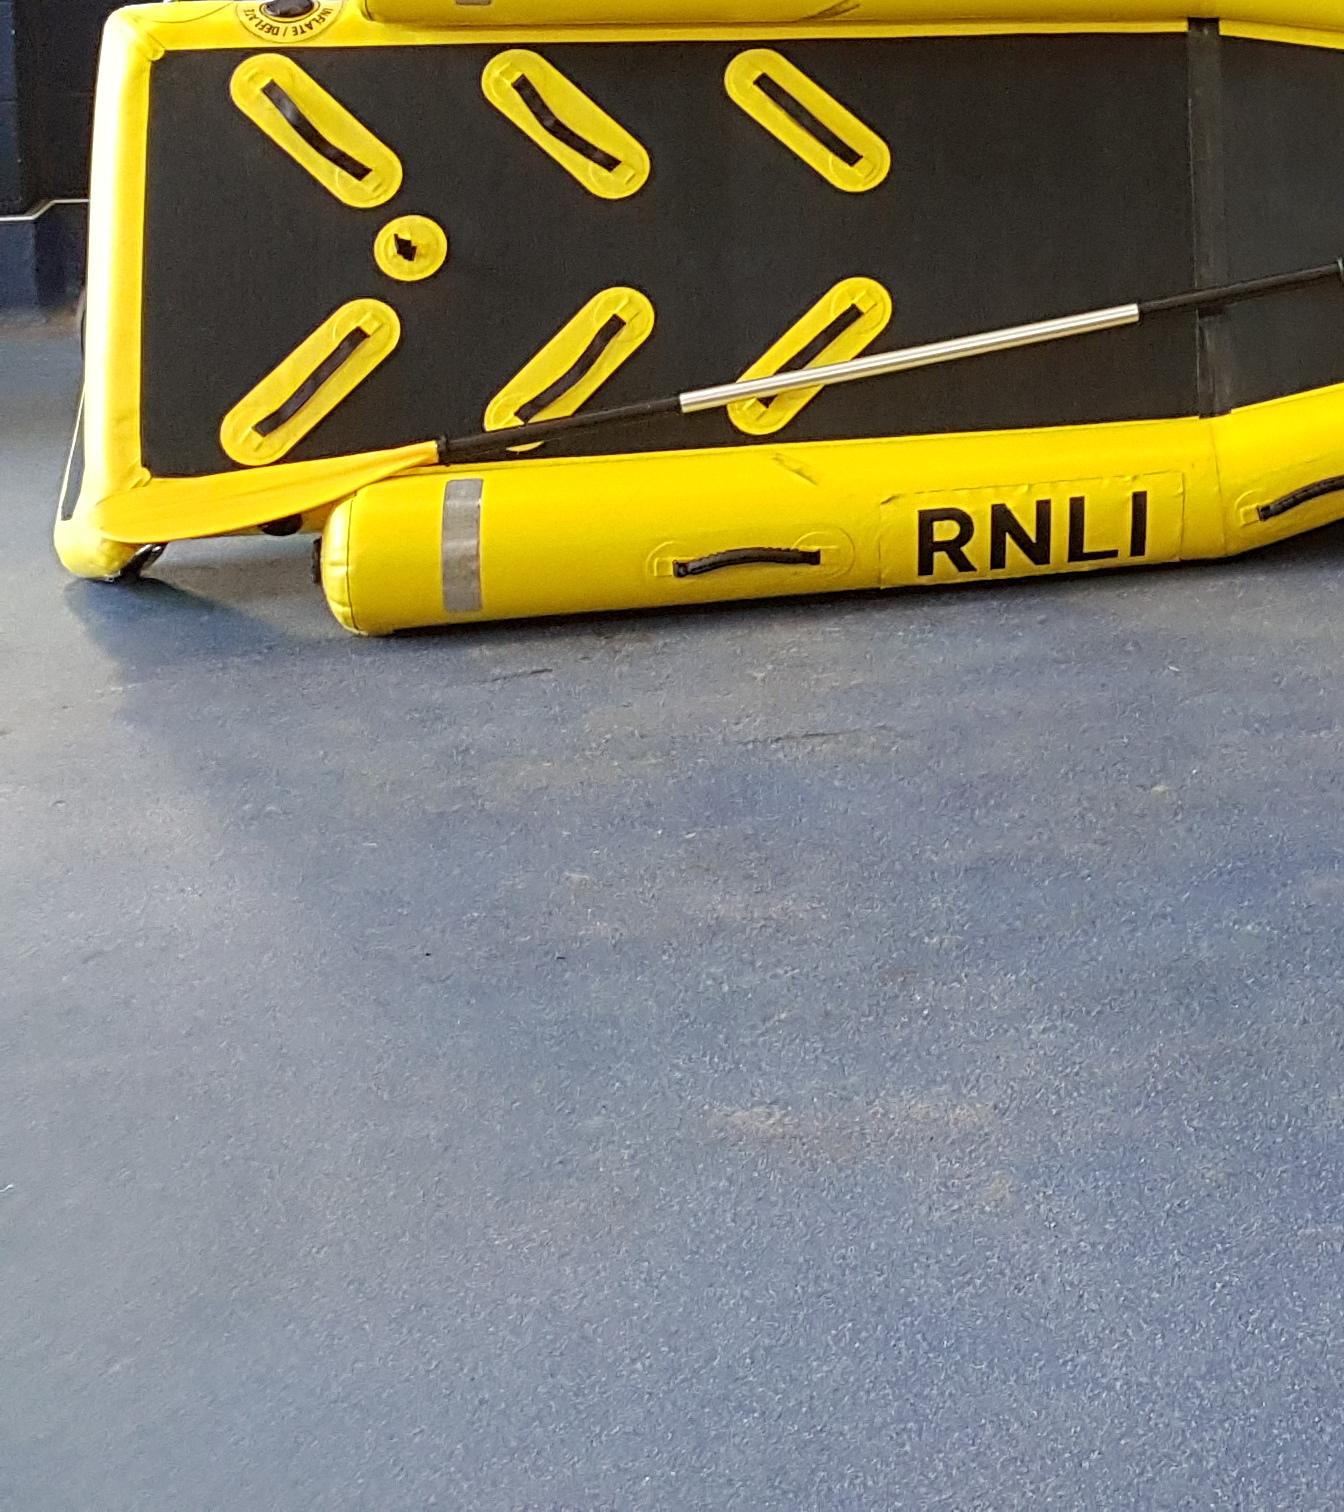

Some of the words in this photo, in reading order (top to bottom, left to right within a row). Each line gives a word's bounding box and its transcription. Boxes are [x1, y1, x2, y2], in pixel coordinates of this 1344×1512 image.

[243, 8, 281, 36] DEFLATE
[292, 7, 334, 37] INFLATE
[917, 490, 1148, 577] RNLI
